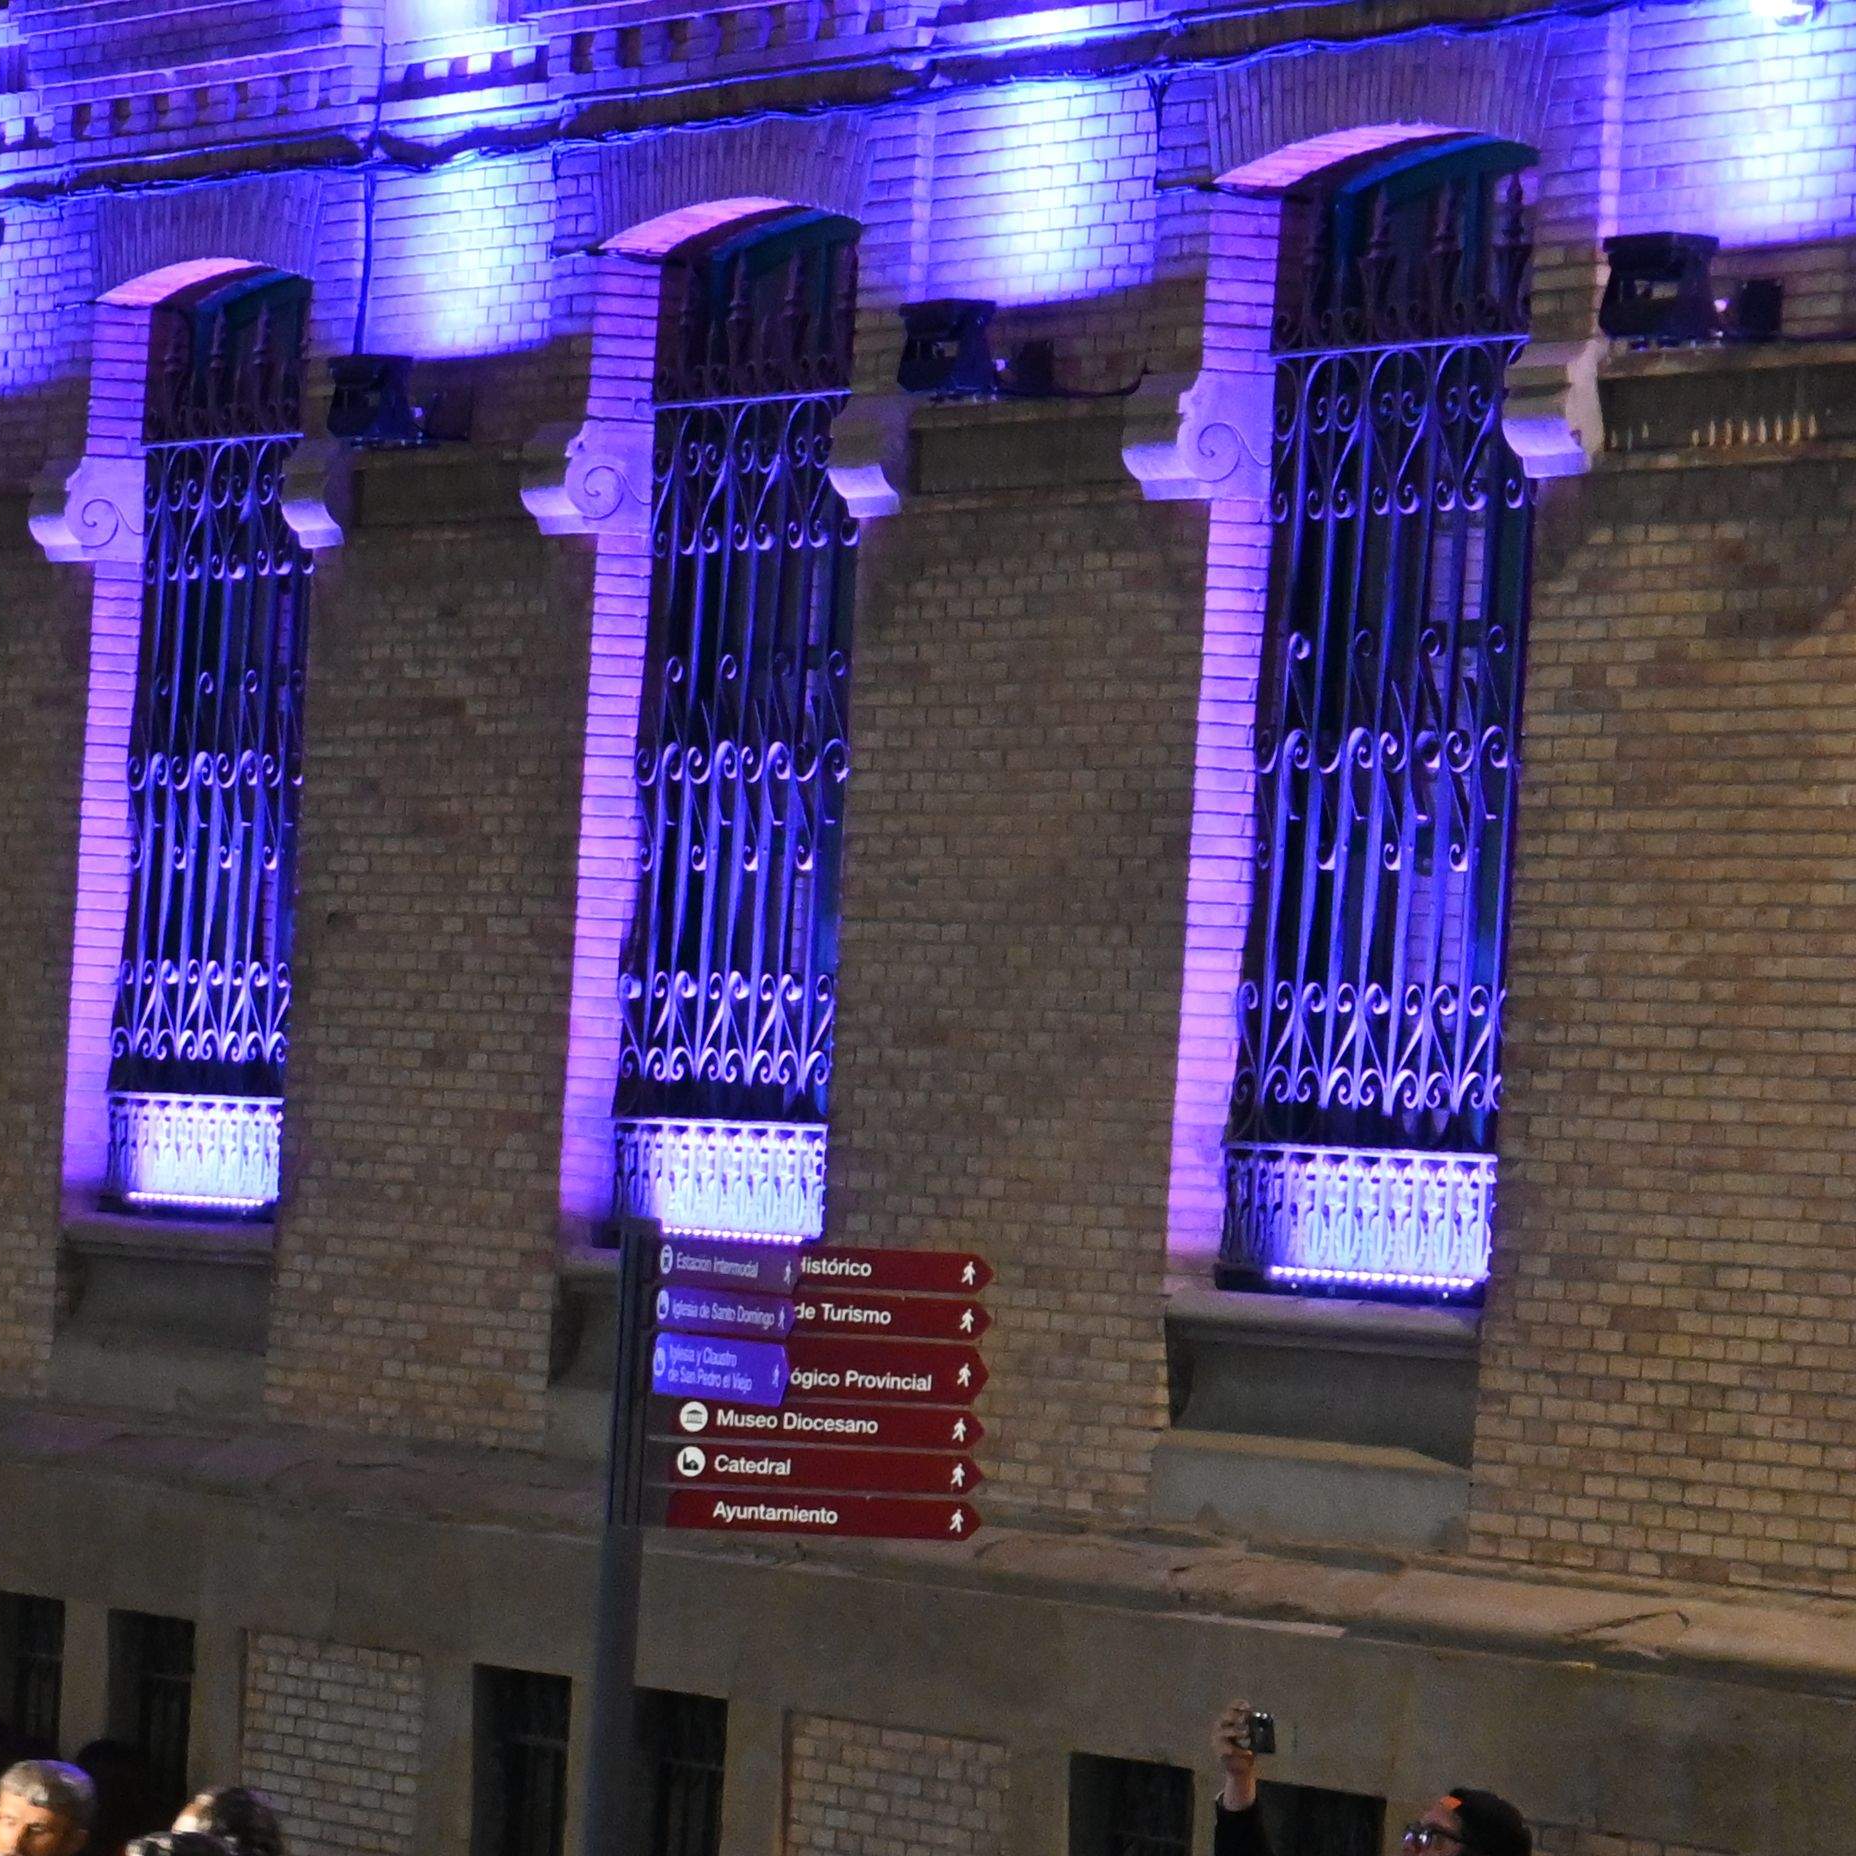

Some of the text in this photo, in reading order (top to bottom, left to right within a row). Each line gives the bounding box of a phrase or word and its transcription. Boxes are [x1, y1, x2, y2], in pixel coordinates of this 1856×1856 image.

[699, 1302, 710, 1319] de
[711, 1303, 736, 1322] Santo
[737, 1305, 775, 1330] Domingo
[794, 1302, 892, 1326] de Turismo
[695, 1351, 702, 1367] y
[703, 1346, 738, 1368] Claustro
[667, 1366, 753, 1395] de San Pedro el Viejo
[790, 1367, 933, 1392] ógico Provincial
[716, 1409, 879, 1435] Museo Diocesano
[714, 1455, 791, 1476] Catedral
[713, 1500, 839, 1525] Ayuntamiento
